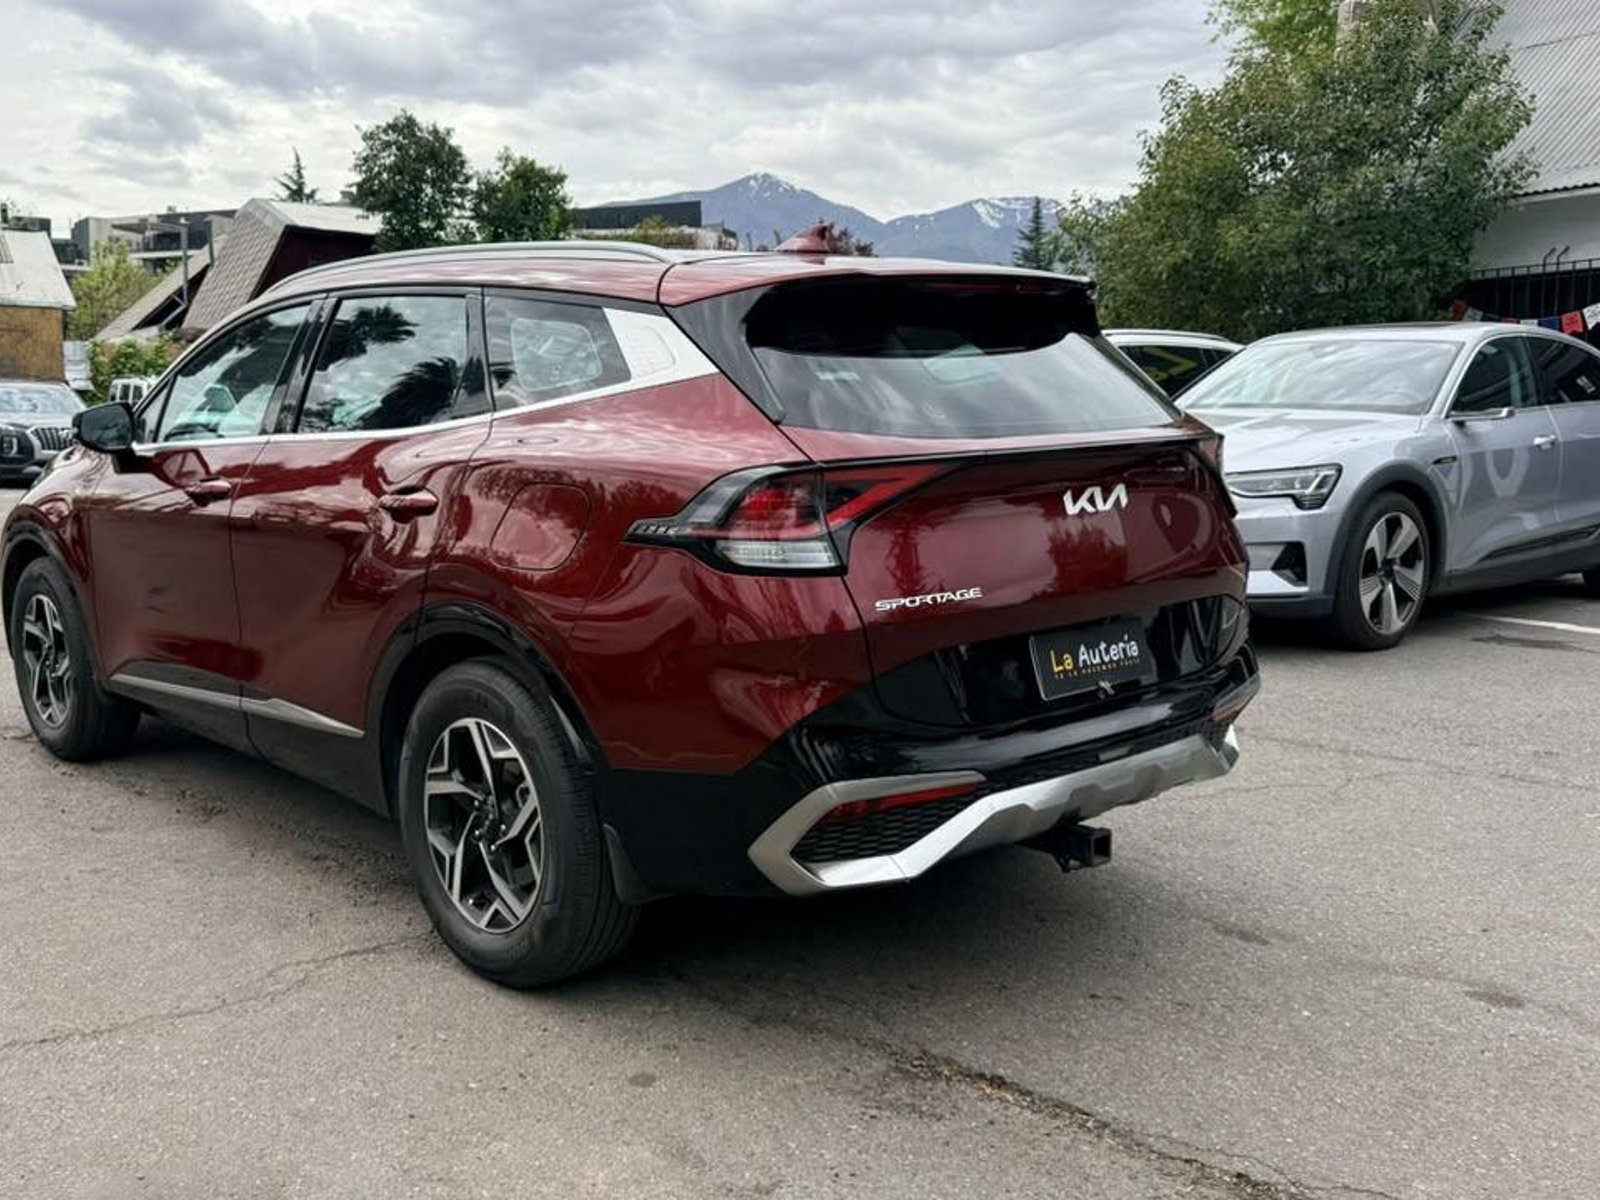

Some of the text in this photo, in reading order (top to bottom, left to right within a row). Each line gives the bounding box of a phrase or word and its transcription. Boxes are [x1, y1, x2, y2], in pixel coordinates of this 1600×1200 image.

[1063, 483, 1128, 515] KIA
[875, 587, 983, 611] SPORTAGE
[1050, 649, 1074, 673] La
[1079, 633, 1139, 667] Autería
